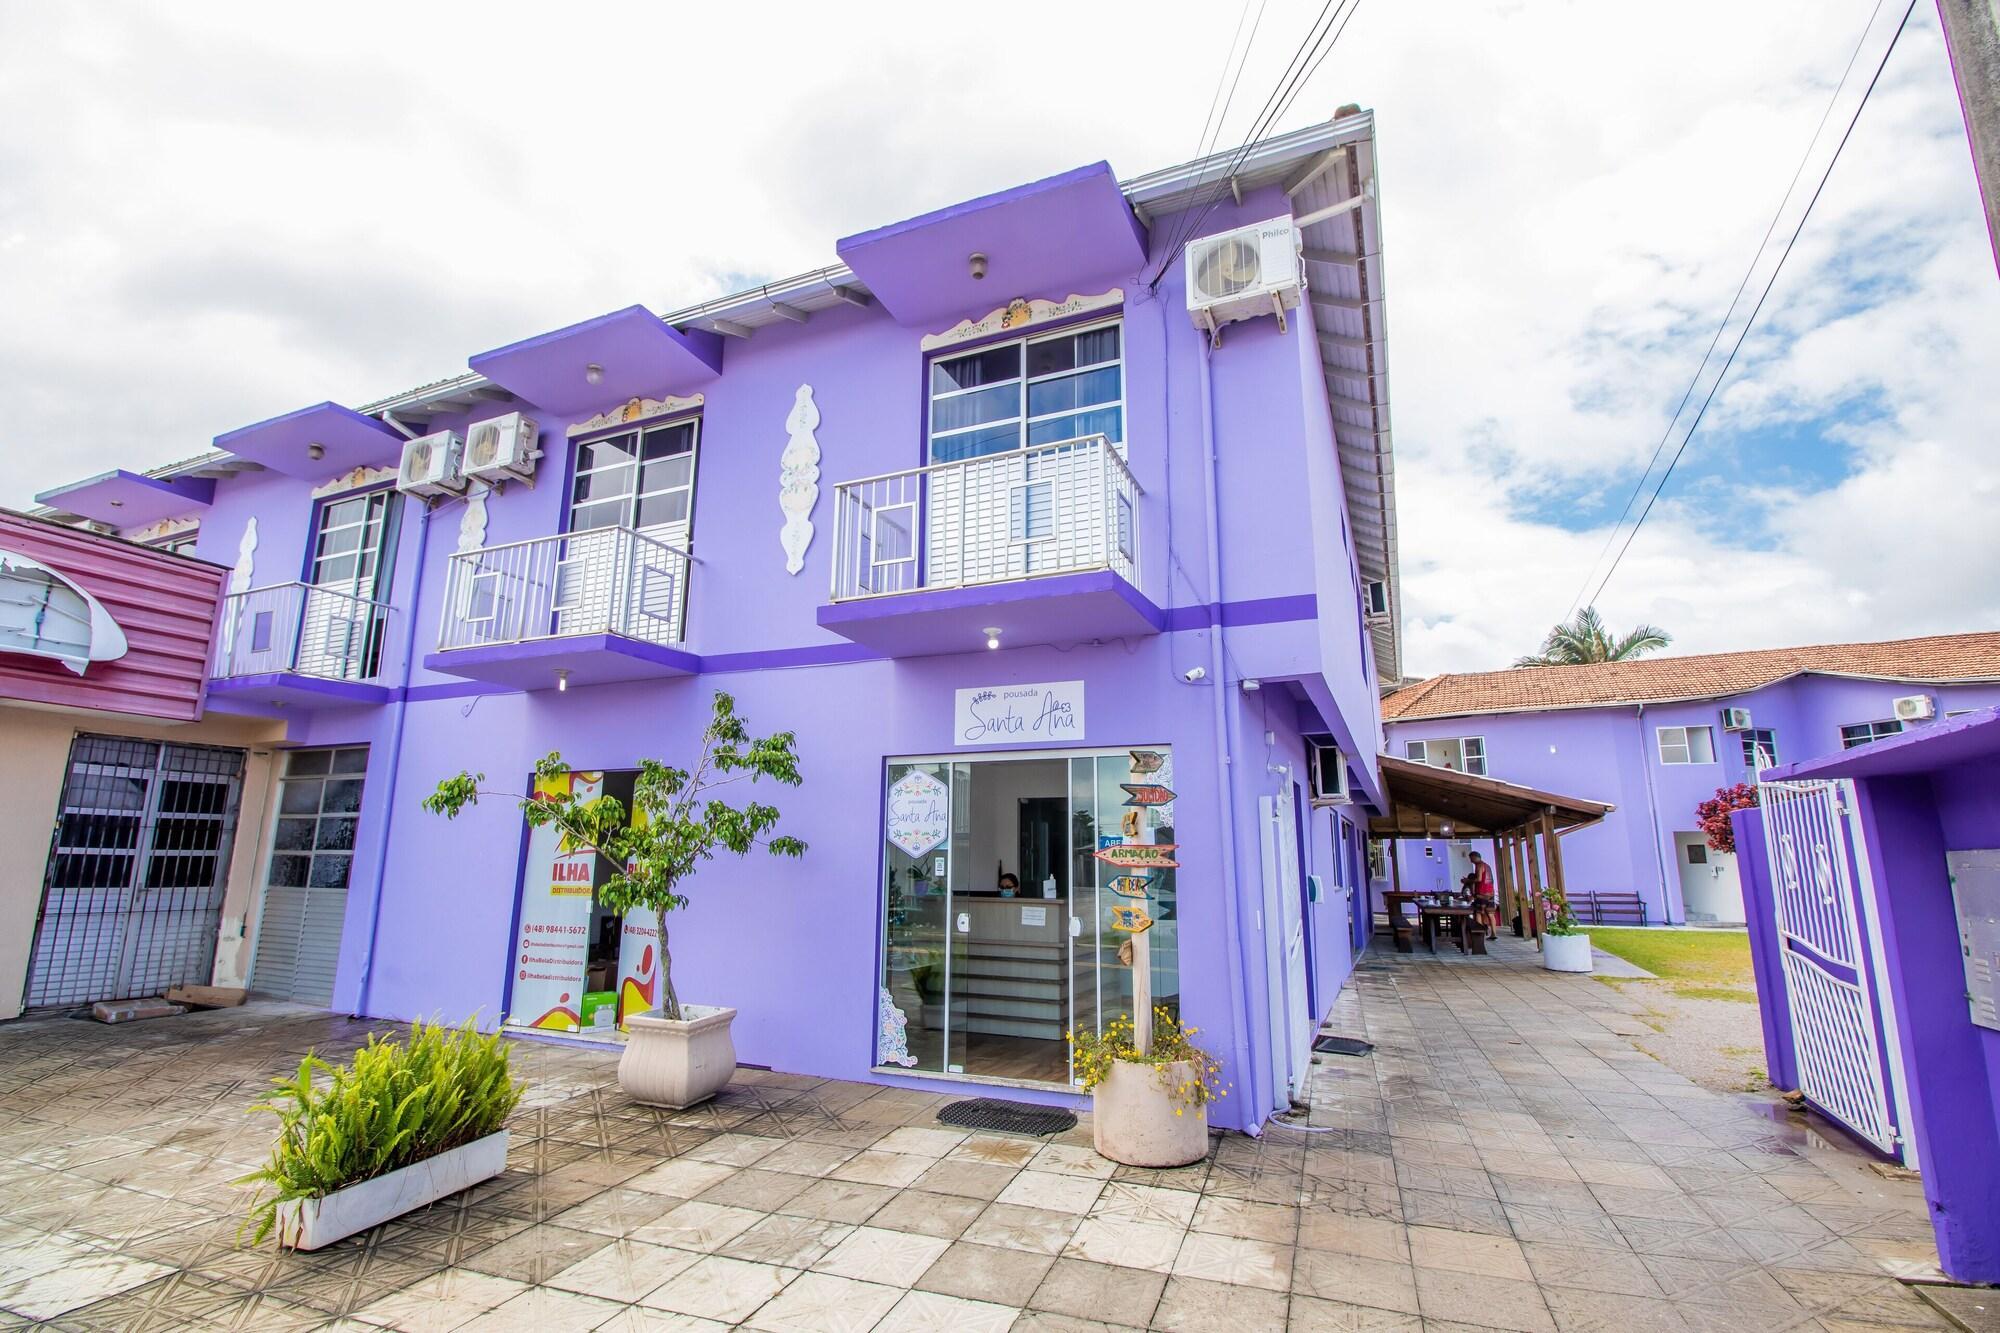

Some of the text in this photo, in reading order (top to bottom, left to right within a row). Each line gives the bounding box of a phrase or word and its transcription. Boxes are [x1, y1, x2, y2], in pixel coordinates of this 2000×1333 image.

[1262, 228, 1289, 239] Philco
[1003, 688, 1038, 700] pousada
[964, 690, 1075, 740] Santa Ana
[888, 799, 947, 826] Santa Ana
[552, 863, 590, 881] ILHA
